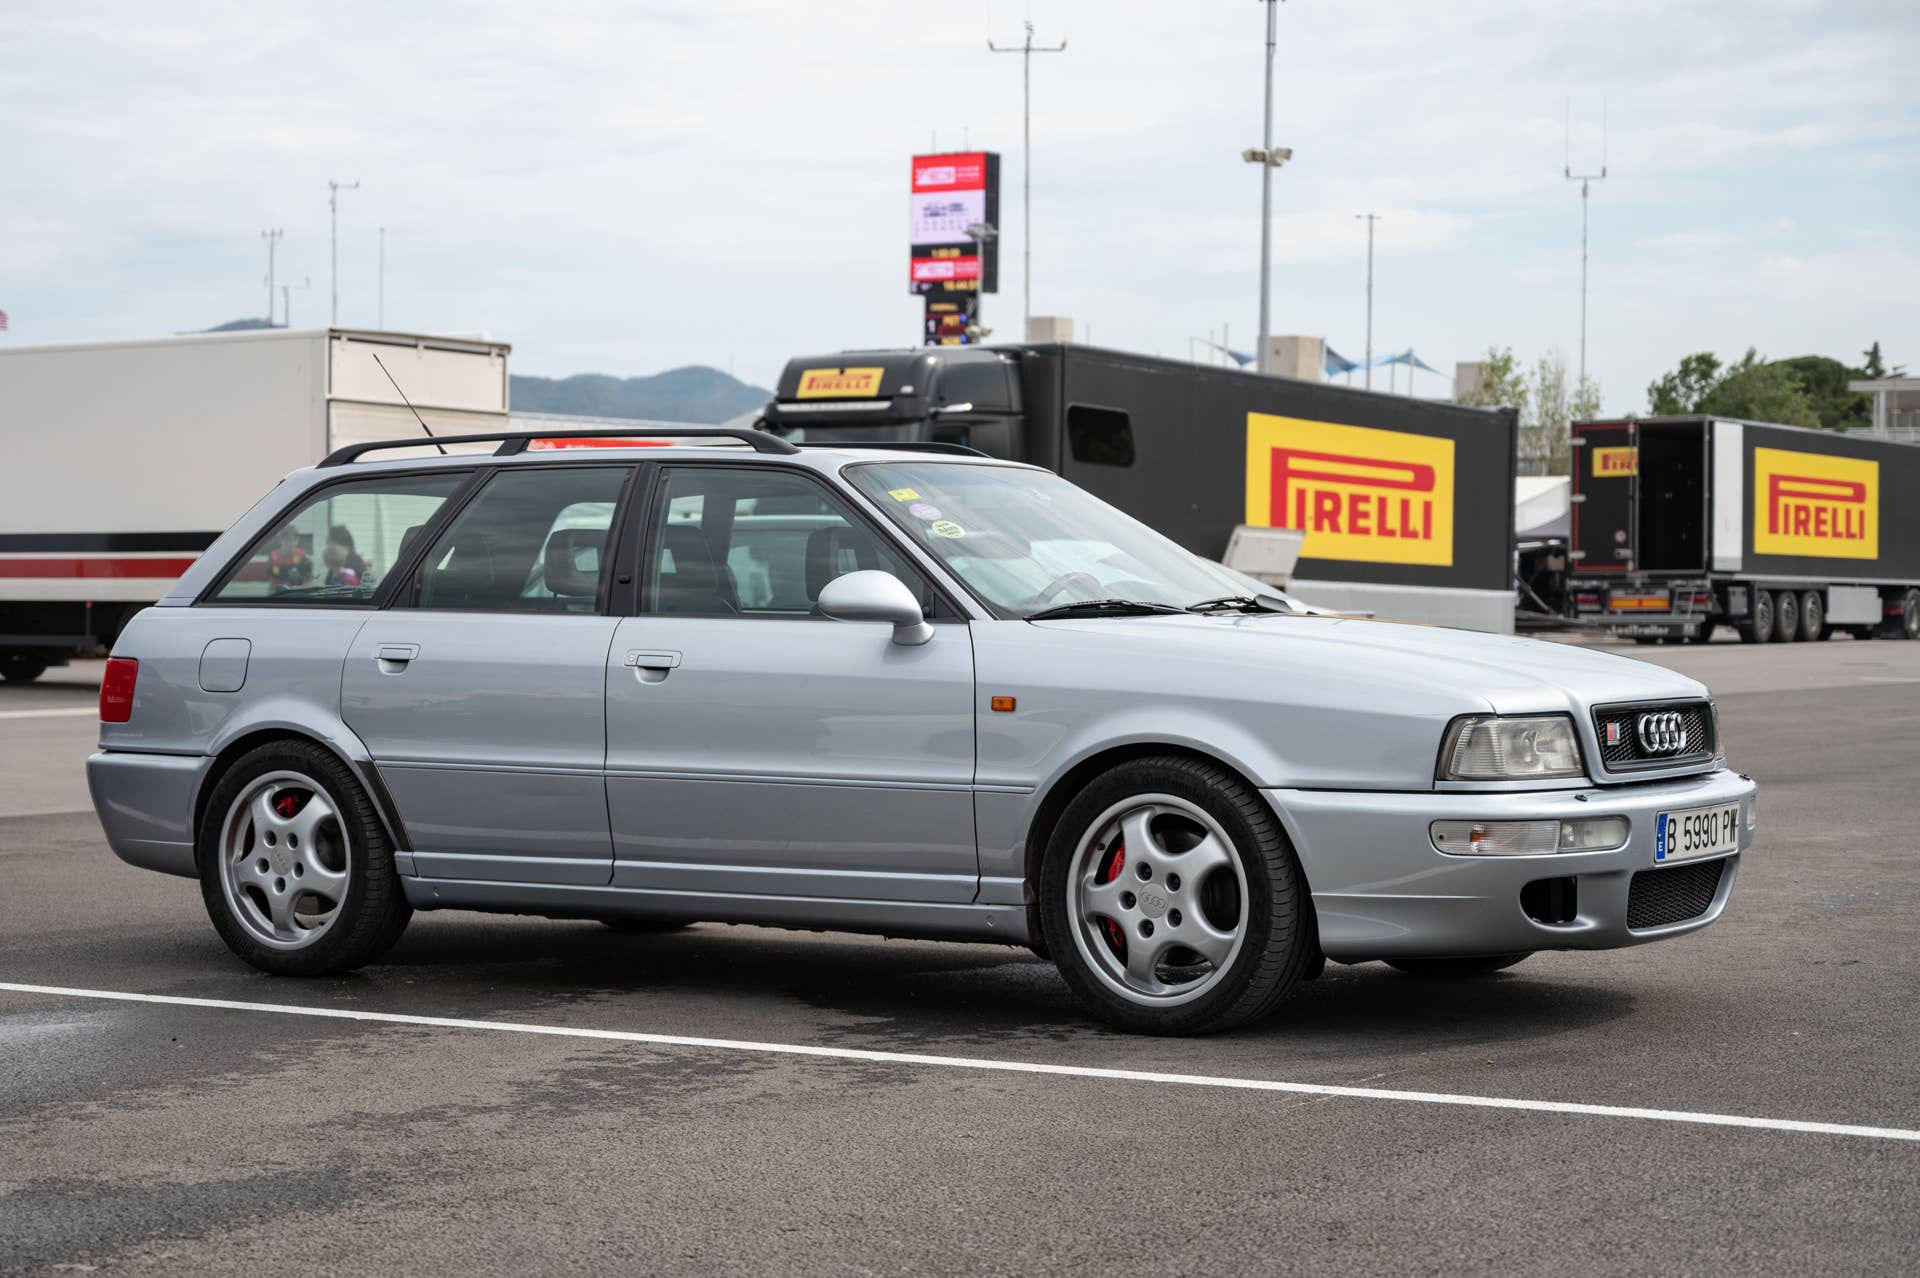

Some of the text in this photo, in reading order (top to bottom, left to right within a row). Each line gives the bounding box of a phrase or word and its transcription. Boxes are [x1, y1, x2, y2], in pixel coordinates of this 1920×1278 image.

[806, 374, 873, 391] PIRELLI
[1269, 445, 1436, 540] PIRELLI
[1768, 473, 1867, 540] PIRELLI
[1658, 842, 1664, 851] E
[1667, 818, 1677, 853] B
[1684, 812, 1718, 851] 5990
